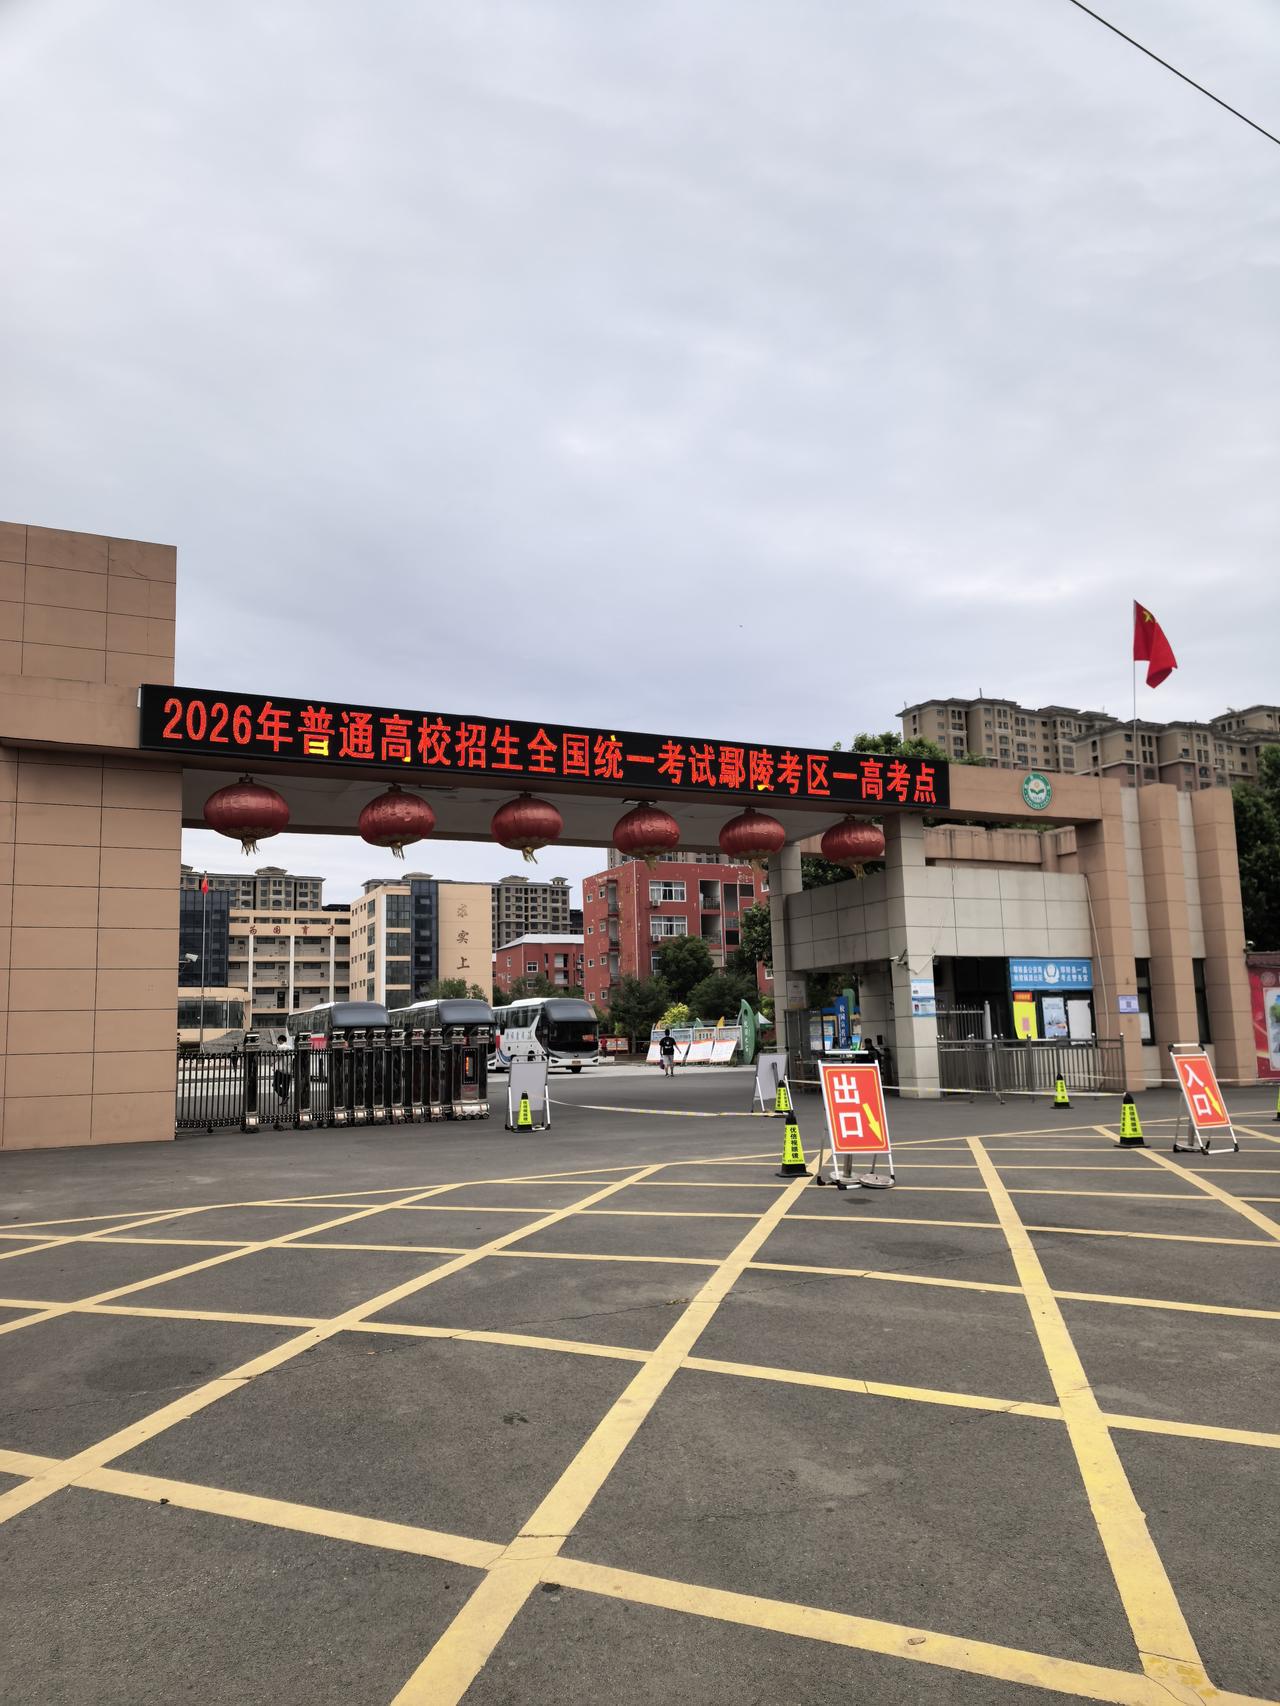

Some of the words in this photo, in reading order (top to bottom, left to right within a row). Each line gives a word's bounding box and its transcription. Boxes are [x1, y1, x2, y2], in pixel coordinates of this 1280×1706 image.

[162, 697, 937, 804] 2026年普通高校招生全国统一考试鄢陵考区一高考点
[833, 1073, 864, 1139] 出口
[1183, 1063, 1213, 1118] 入口
